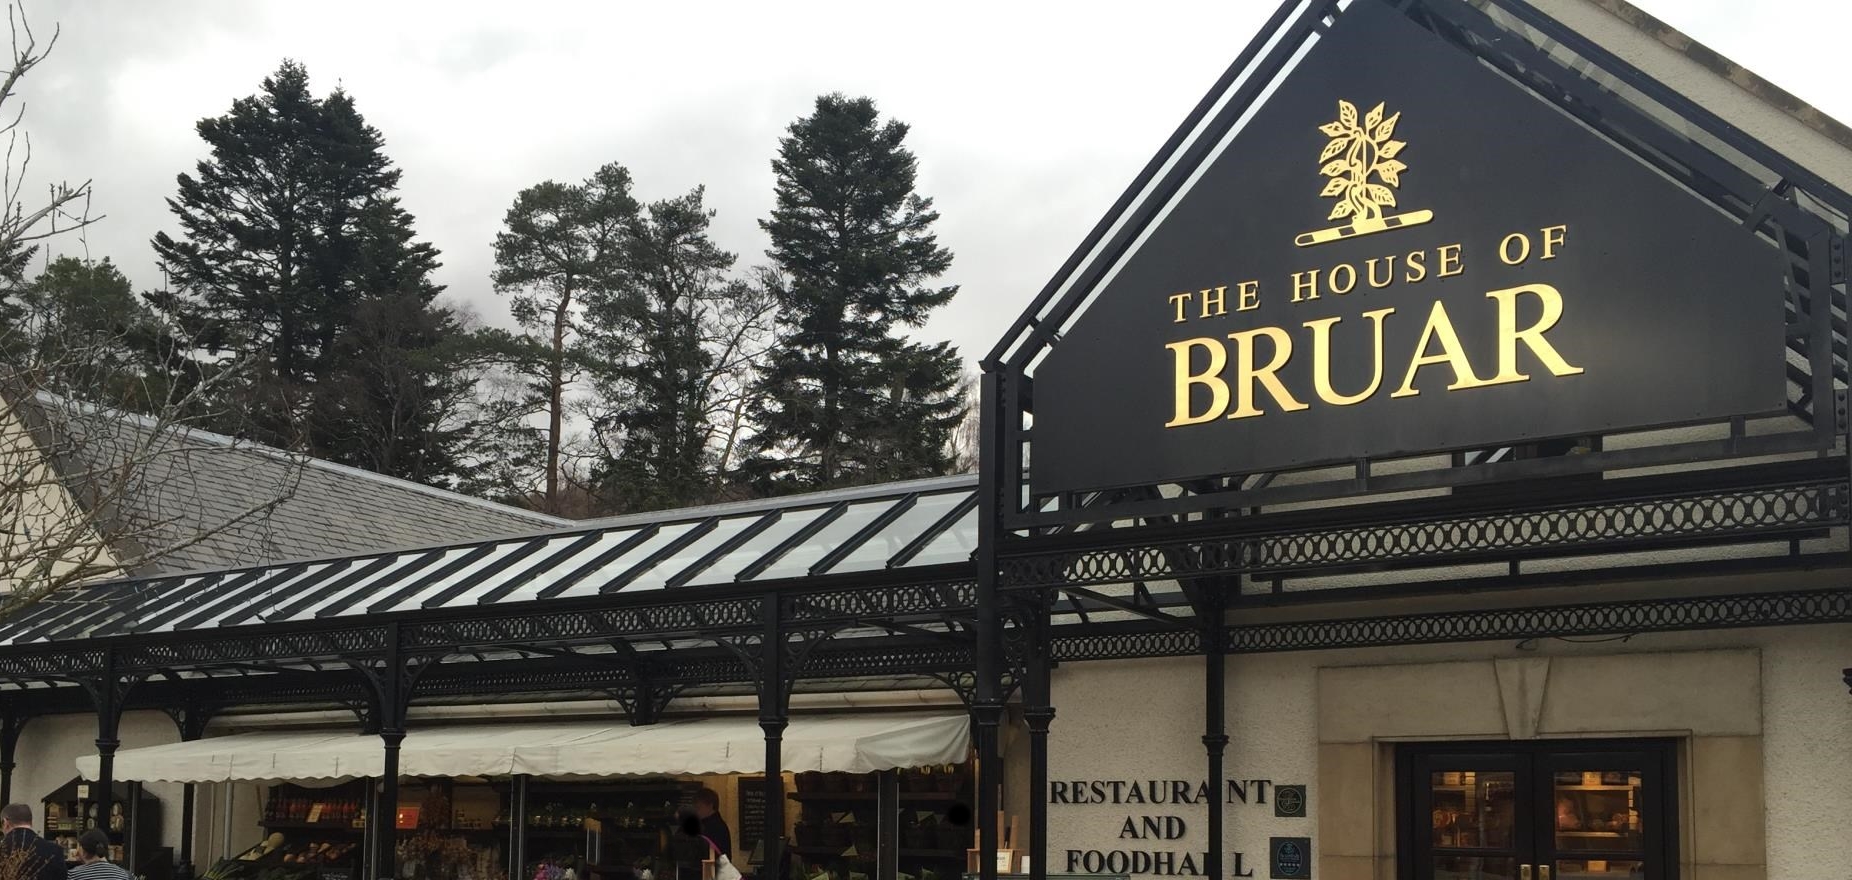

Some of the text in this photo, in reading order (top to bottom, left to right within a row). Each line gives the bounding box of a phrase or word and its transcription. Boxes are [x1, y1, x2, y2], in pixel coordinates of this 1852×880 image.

[1169, 224, 1568, 323] THE HOUSE OF
[1165, 283, 1584, 428] BRUAR
[1050, 779, 1271, 804] RESTAURANT
[1118, 815, 1186, 840] AND
